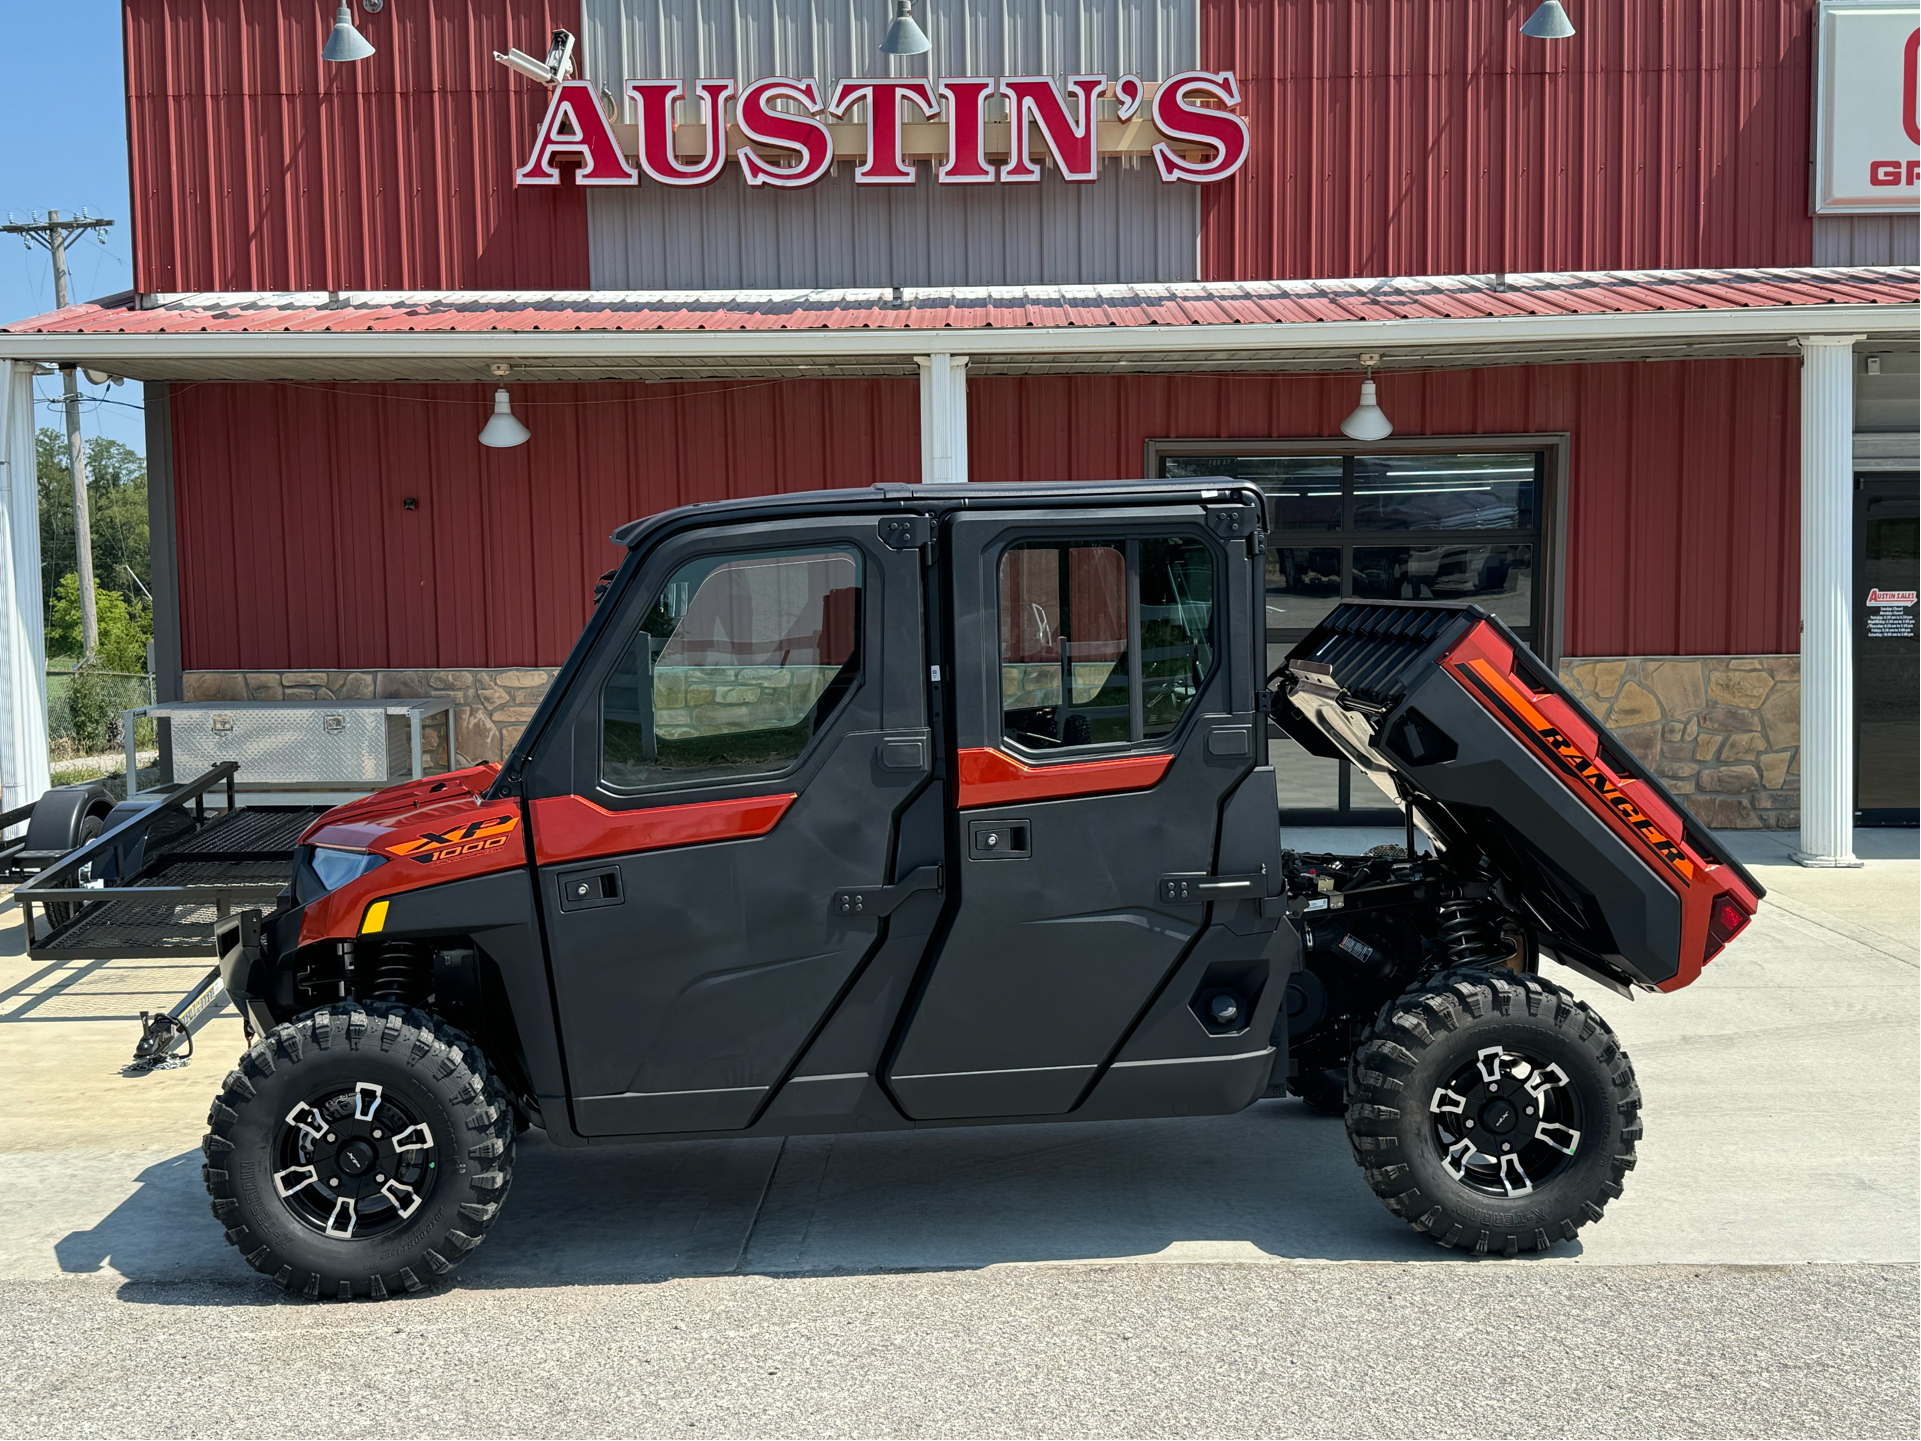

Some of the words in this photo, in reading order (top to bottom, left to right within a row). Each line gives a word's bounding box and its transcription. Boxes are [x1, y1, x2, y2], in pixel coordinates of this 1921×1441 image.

[514, 70, 1252, 189] AUSTIN'S
[1868, 590, 1896, 603] AUSTIN
[1538, 727, 1687, 864] RANGER
[405, 814, 515, 853] XP
[431, 835, 509, 861] 1000
[239, 1159, 295, 1250] X-TERRAIN
[1450, 1197, 1549, 1228] X-TERRAIN
